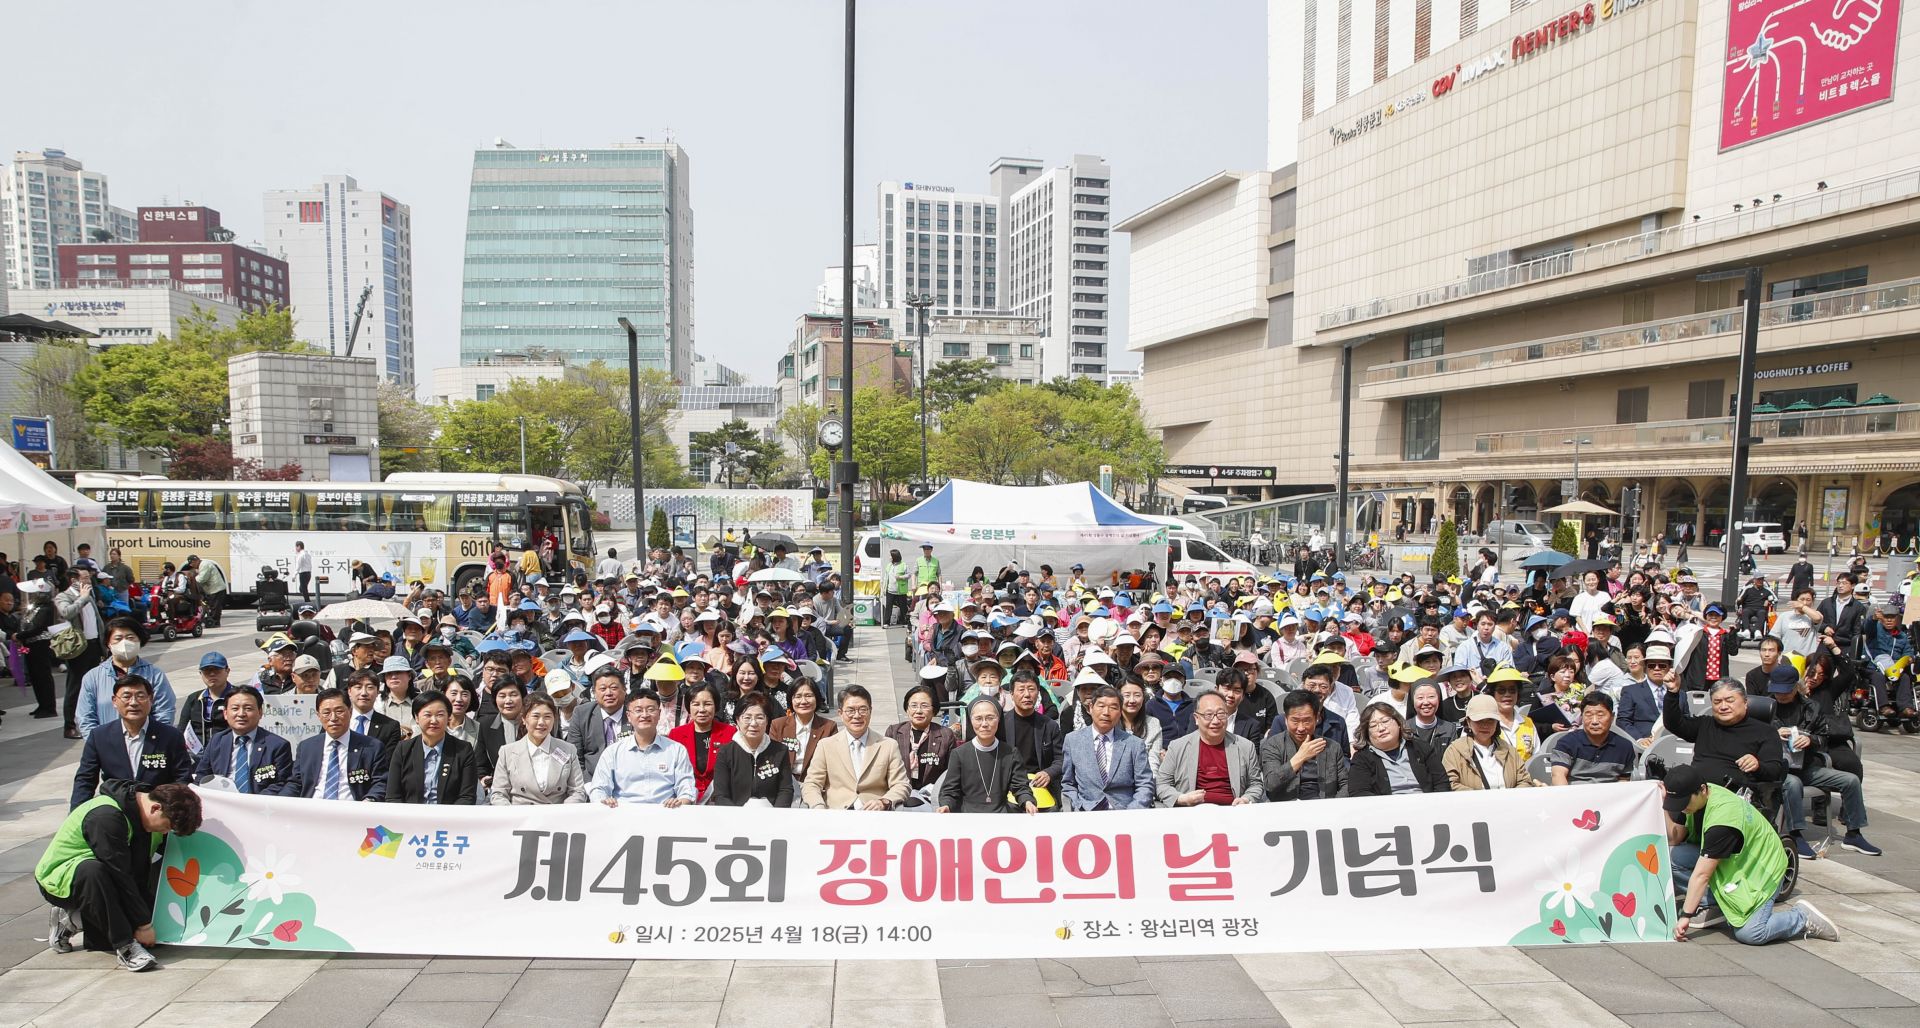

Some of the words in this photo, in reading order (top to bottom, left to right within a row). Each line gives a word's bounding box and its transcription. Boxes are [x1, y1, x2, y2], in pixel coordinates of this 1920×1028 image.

[1461, 50, 1505, 83] IMAX
[1866, 62, 1874, 71] 곳
[1432, 72, 1456, 98] CGV
[1356, 109, 1382, 136] 영풍문고
[552, 152, 588, 163] 성동구청
[915, 184, 955, 193] SHINYOUNG
[1806, 366, 1813, 374] &
[1815, 362, 1849, 373] COFFEE
[95, 490, 139, 502] 왕십리역
[456, 493, 484, 503] 인천공항
[970, 529, 1016, 541] 운영본부
[109, 537, 143, 550] irport
[148, 537, 211, 548] Limousine
[461, 540, 494, 557] 6010
[142, 759, 167, 769] 박성근
[408, 830, 470, 858] 성동구
[415, 862, 462, 871] 스마트포용도시
[504, 831, 787, 906] 제45회
[818, 833, 1137, 906] 장애인의
[1163, 833, 1239, 902] 날
[1264, 822, 1497, 898] 기념식
[1083, 920, 1121, 939] 장소
[1140, 918, 1215, 939] 왕십리역
[1222, 917, 1259, 937] 광장
[635, 925, 673, 944] 일시
[694, 926, 763, 944] 2025년
[770, 925, 802, 944] 4월
[812, 925, 868, 945] 18(금)
[876, 926, 932, 943] 14:00
